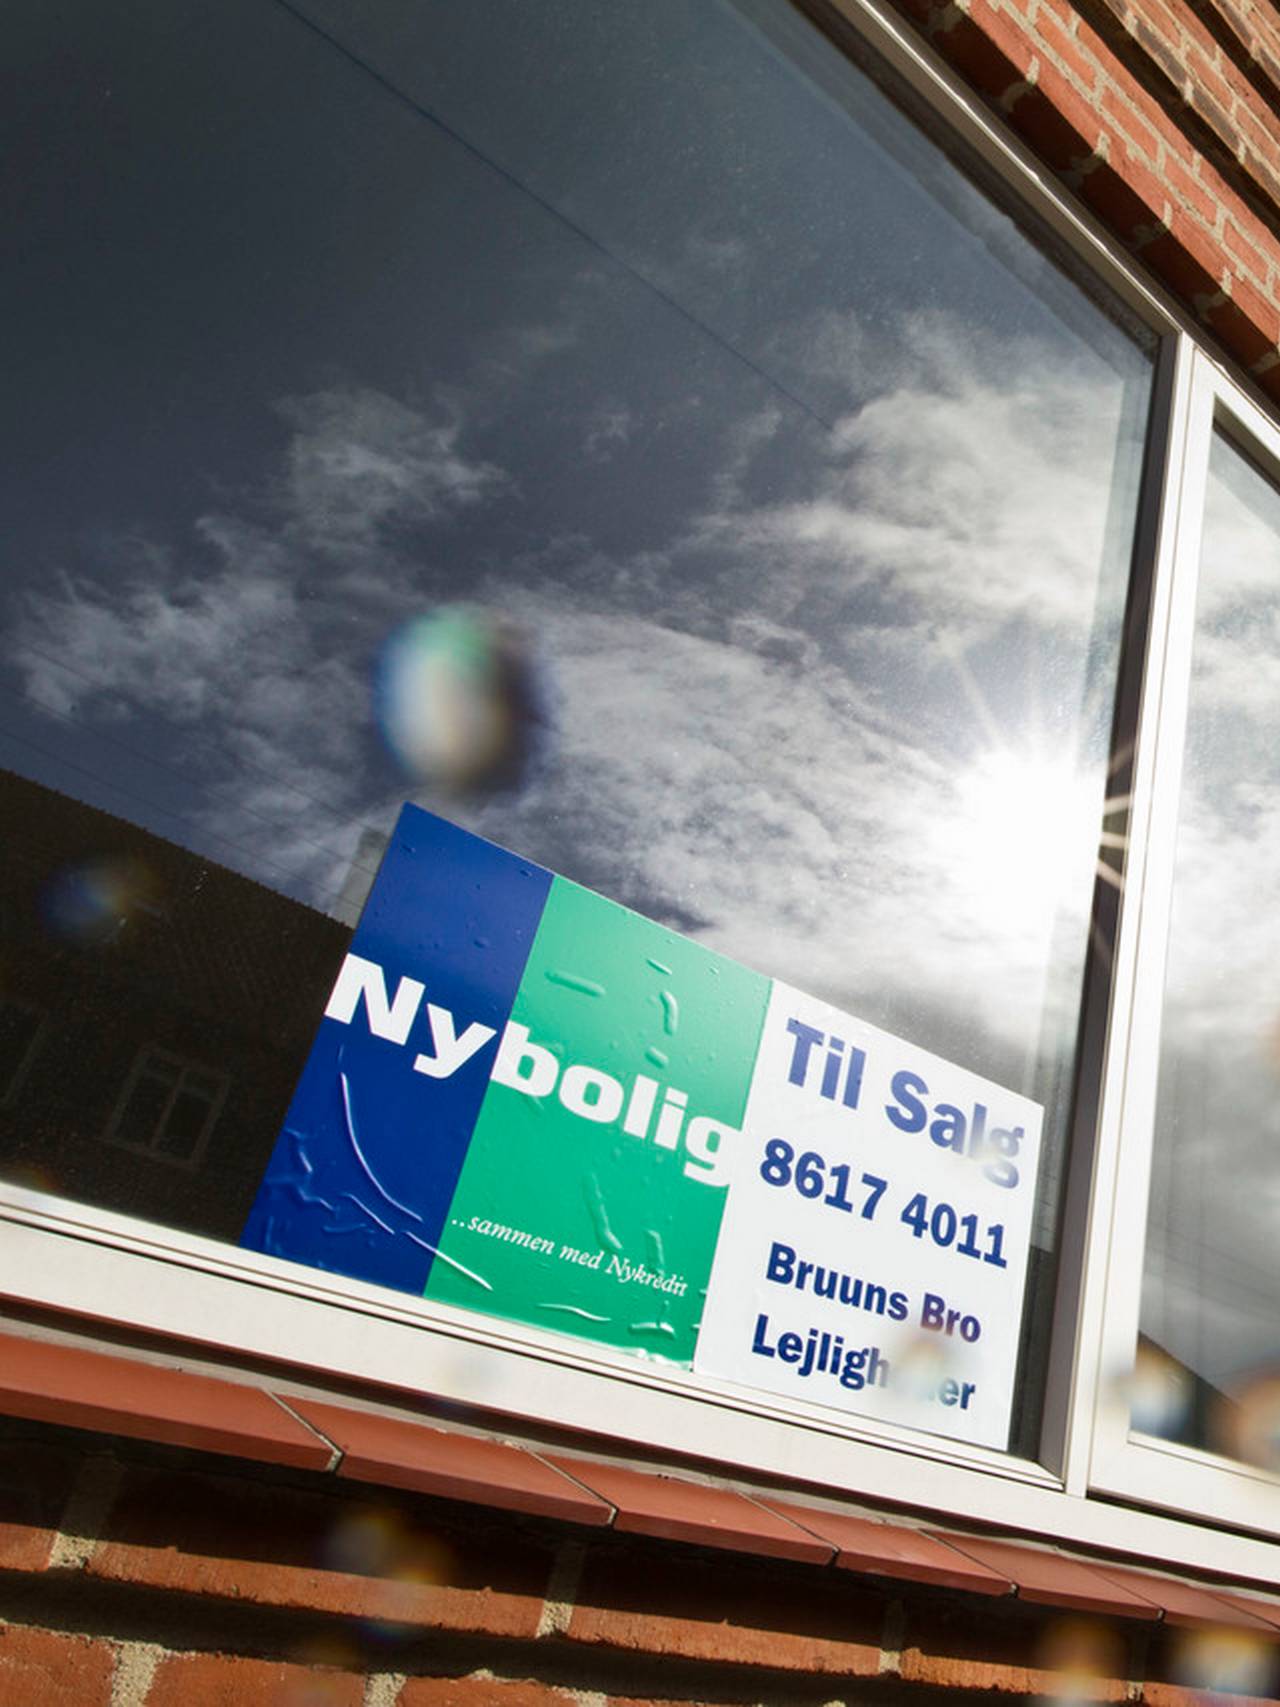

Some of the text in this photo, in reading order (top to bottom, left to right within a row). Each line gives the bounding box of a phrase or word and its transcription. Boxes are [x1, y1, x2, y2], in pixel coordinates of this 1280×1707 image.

[323, 952, 744, 1187] Nybolig
[785, 1017, 1025, 1190] Til Salg
[759, 1138, 1008, 1269] 8617 4011
[559, 1244, 605, 1270] med
[604, 1254, 688, 1297] Nykredit
[765, 1242, 982, 1343] Bruuns Bro
[751, 1313, 976, 1411] Lejligher
